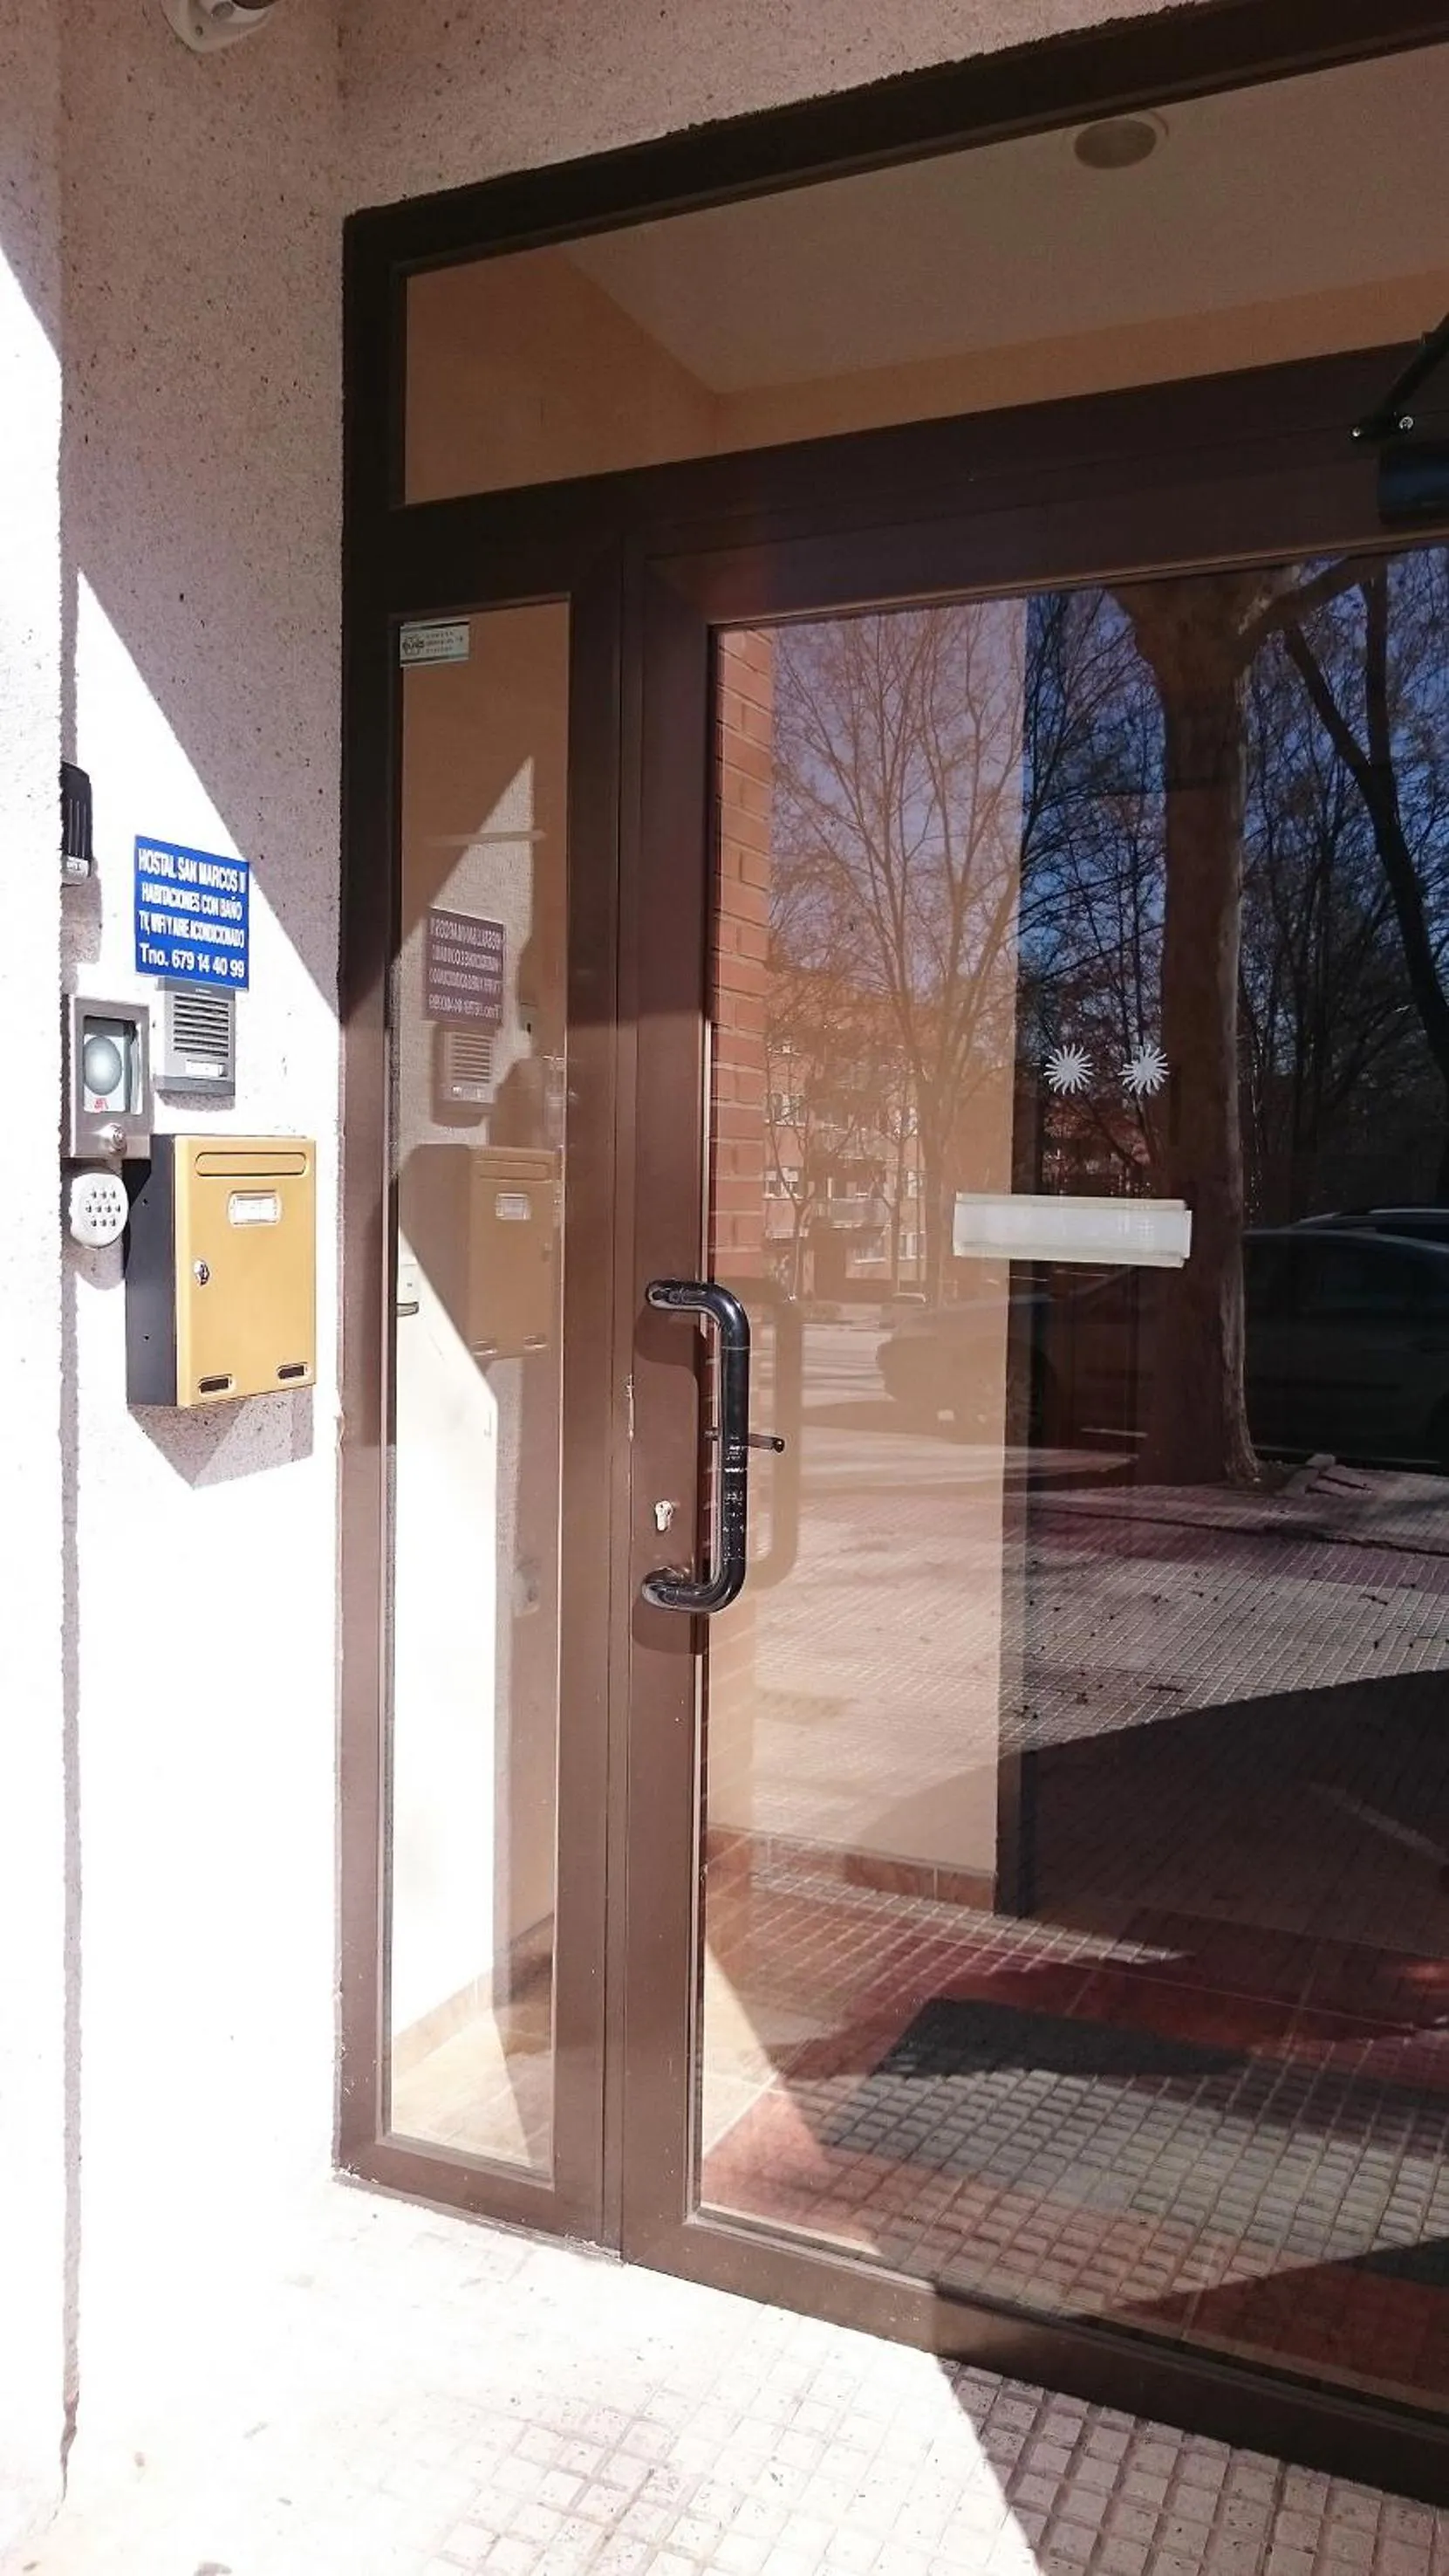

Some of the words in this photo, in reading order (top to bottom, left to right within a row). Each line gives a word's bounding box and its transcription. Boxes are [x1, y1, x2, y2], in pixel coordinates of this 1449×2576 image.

[139, 849, 176, 878] HOSTAL
[178, 857, 197, 882] SAN
[199, 862, 237, 892] MARCOS
[142, 883, 200, 912] HABITACIONES
[202, 895, 218, 915] CON
[220, 897, 242, 920] BAÑO
[167, 916, 172, 934] Y
[140, 943, 168, 965] Tno.
[172, 950, 194, 969] 679
[198, 954, 209, 971] 14
[213, 957, 228, 975] 40
[230, 960, 244, 977] 99
